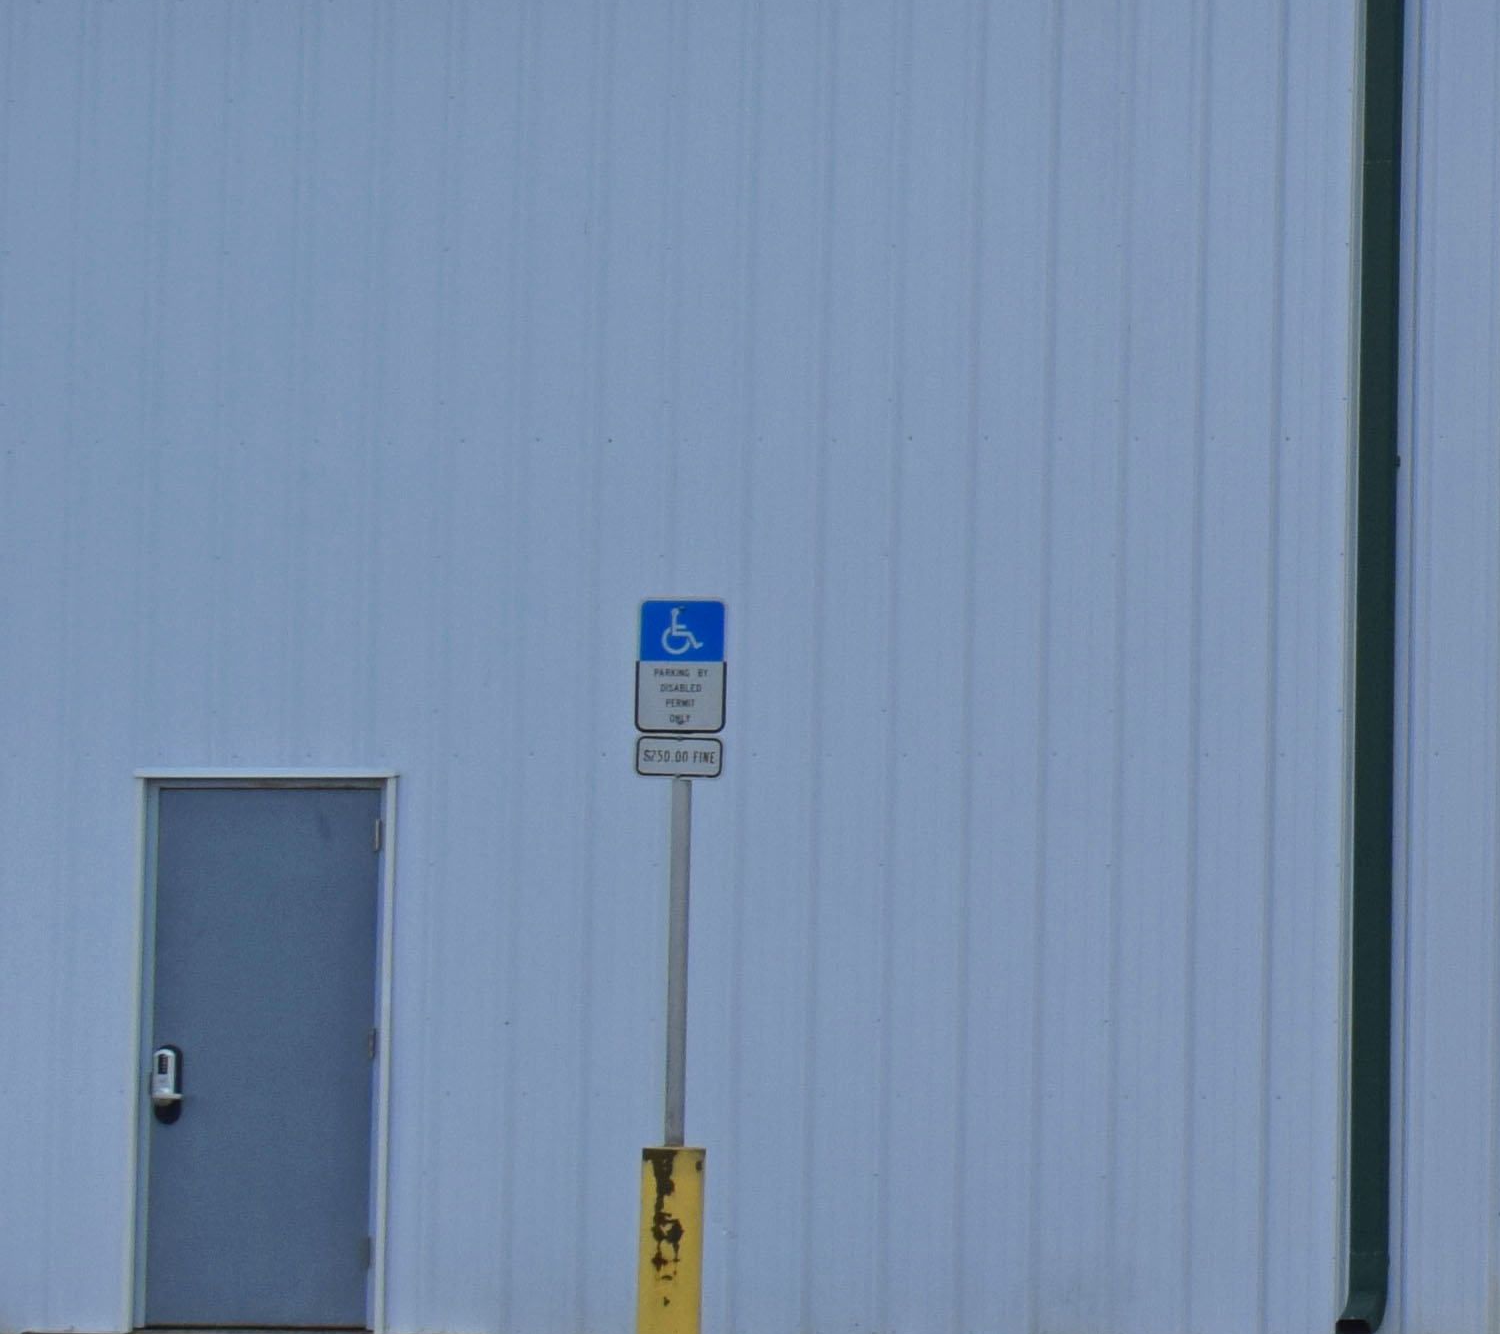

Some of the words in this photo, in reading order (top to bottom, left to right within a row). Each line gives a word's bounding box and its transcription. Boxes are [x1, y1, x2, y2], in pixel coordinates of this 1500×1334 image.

[653, 668, 690, 677] PARKING
[697, 668, 708, 677] BY
[660, 683, 702, 692] DISABLED
[665, 698, 695, 708] PERMIT
[669, 714, 690, 723] ONLY
[693, 751, 716, 764] FINE
